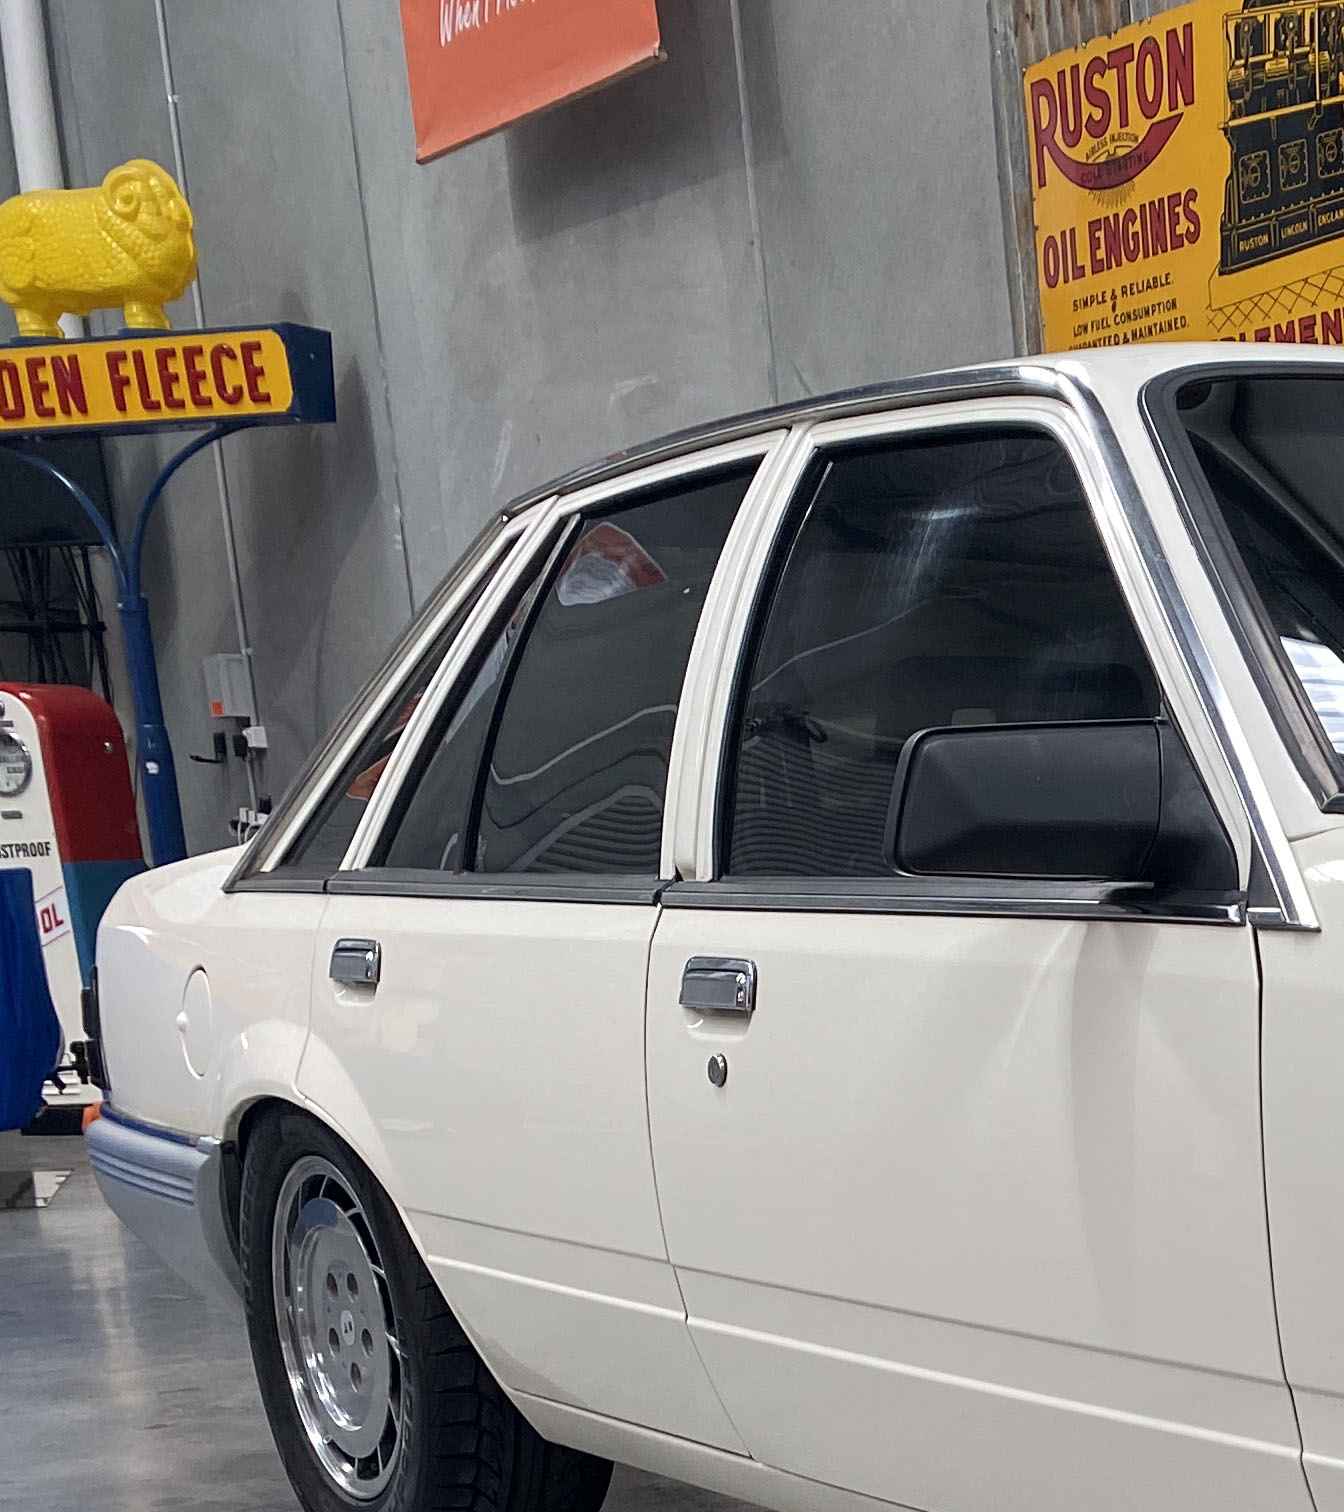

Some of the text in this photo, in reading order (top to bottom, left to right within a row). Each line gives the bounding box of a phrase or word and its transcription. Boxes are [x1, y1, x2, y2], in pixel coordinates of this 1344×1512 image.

[1030, 22, 1194, 189] RUSTON
[1043, 188, 1201, 289] OIL ENGINES
[1239, 233, 1269, 253] RUSTON
[1281, 220, 1309, 239] LINCOLN
[1072, 297, 1178, 338] LOW FUEL CONSUMPTION
[1073, 291, 1108, 312] SIMPLE
[1110, 288, 1118, 301] &
[106, 341, 272, 413] FLEECE
